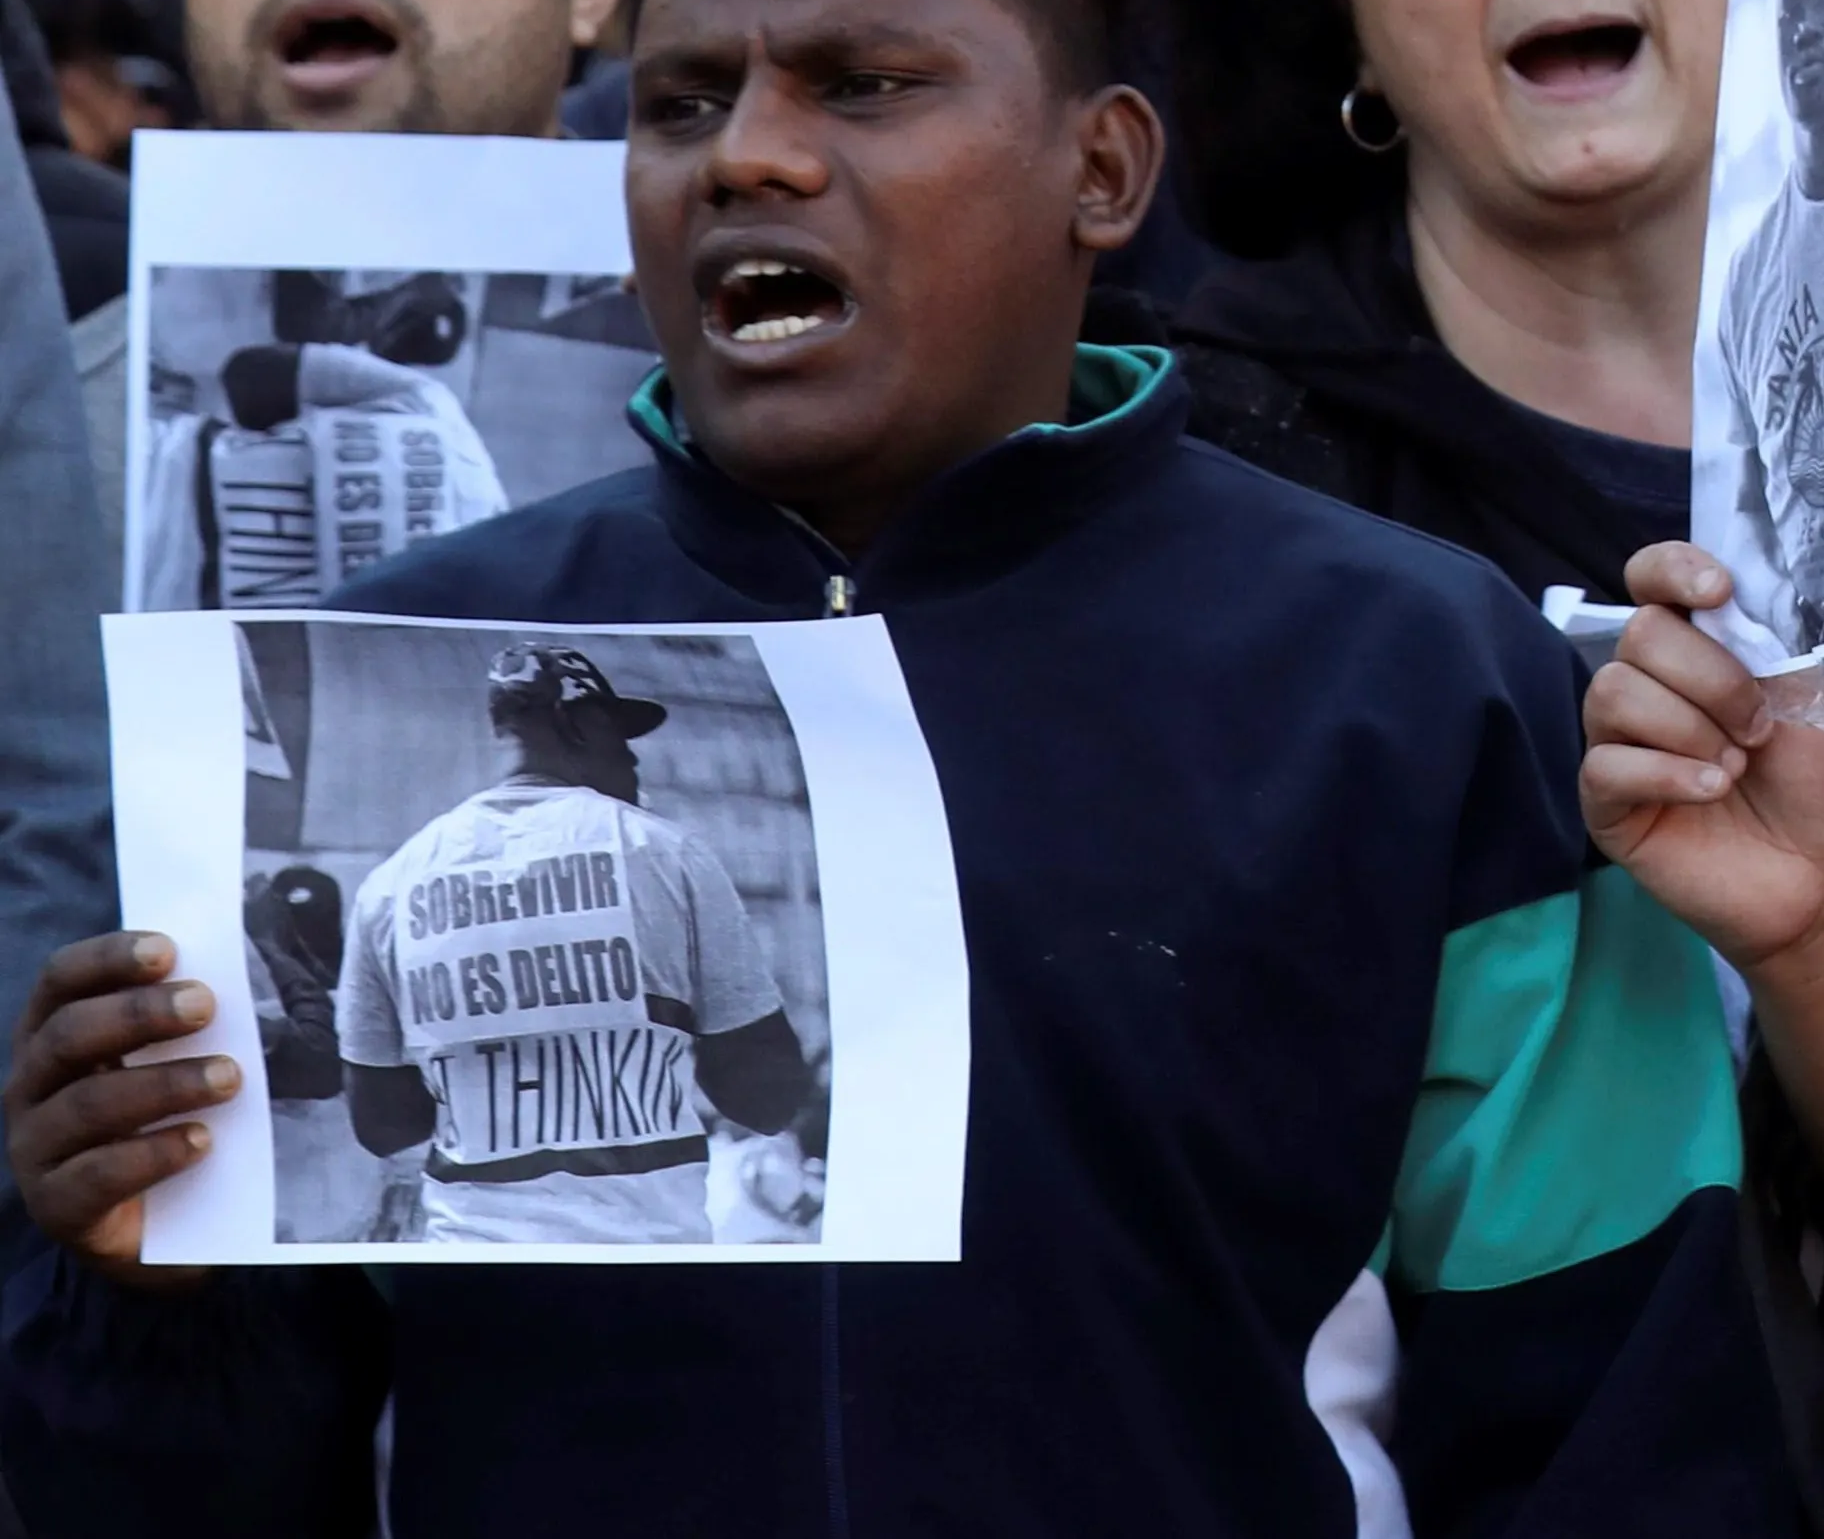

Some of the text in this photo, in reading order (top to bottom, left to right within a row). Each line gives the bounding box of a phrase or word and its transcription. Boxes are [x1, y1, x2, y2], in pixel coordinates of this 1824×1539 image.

[335, 470, 382, 512] ES
[408, 850, 620, 941] SOBREVIVIR
[407, 935, 638, 1026] NO ES DELITO
